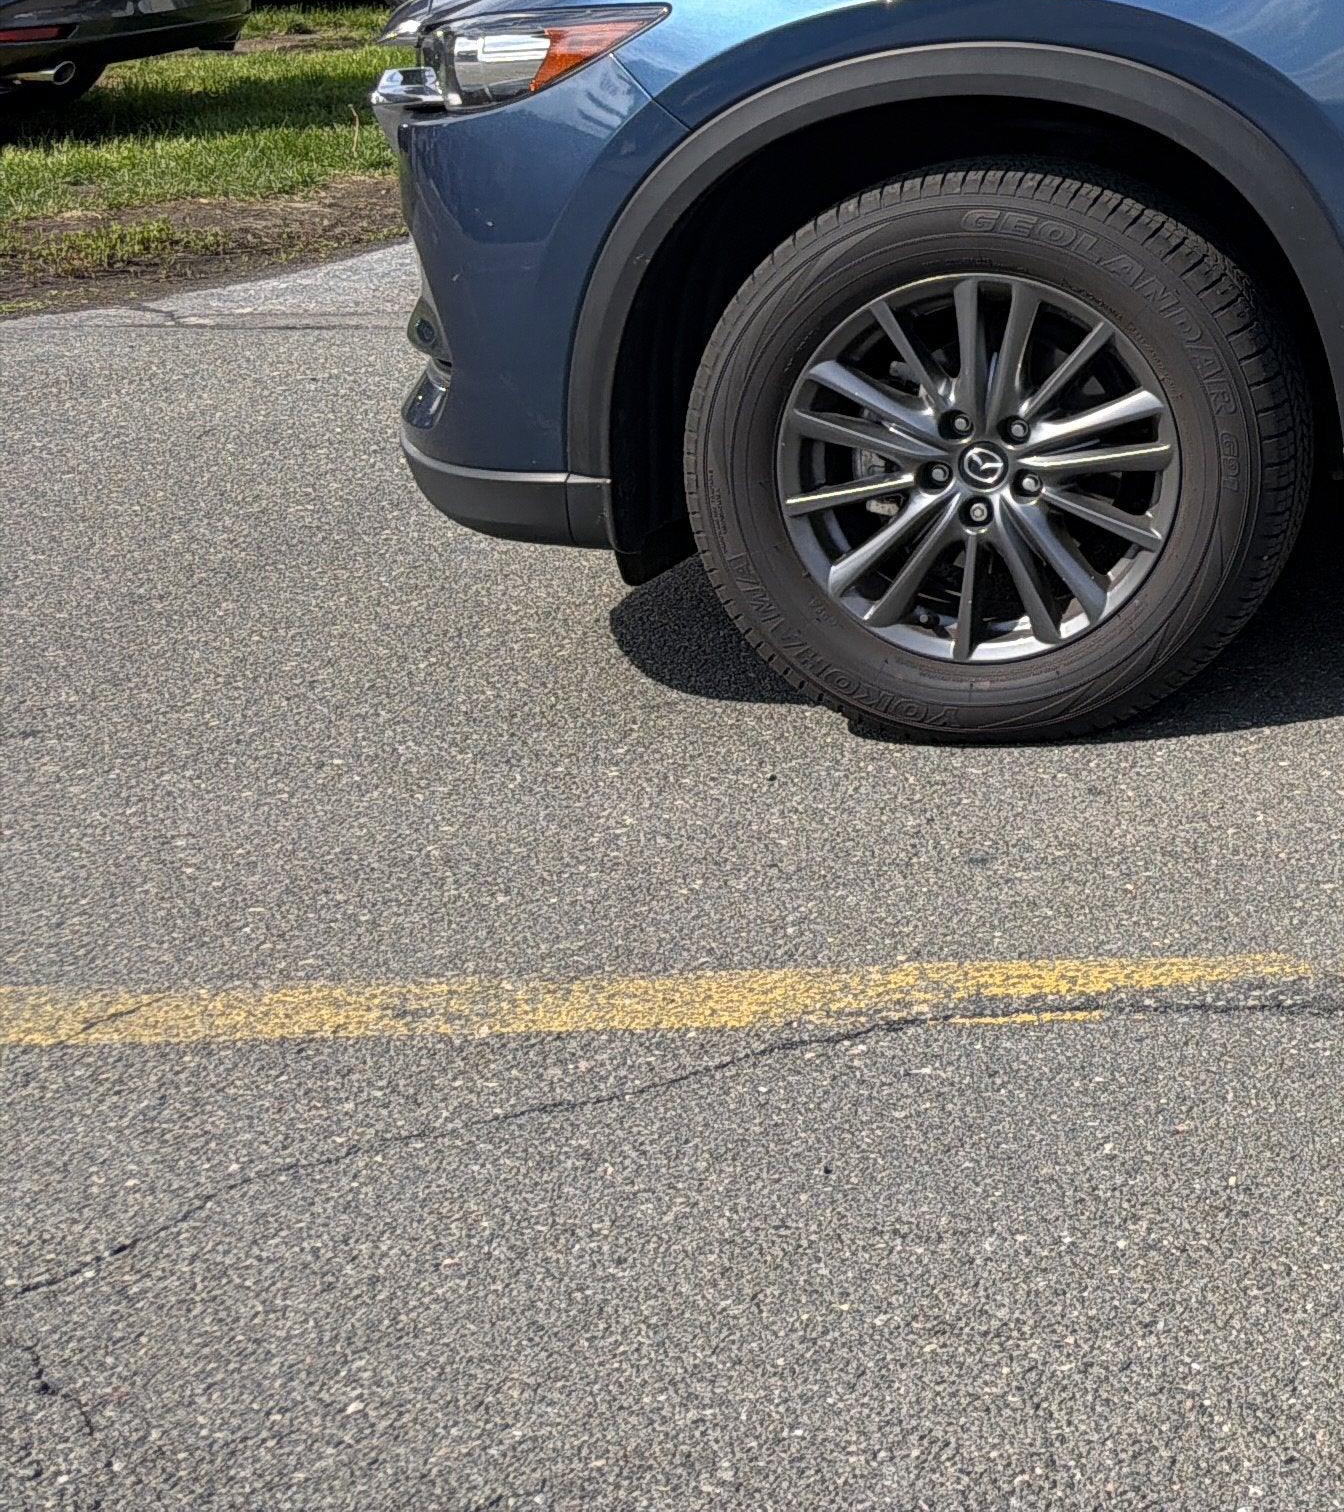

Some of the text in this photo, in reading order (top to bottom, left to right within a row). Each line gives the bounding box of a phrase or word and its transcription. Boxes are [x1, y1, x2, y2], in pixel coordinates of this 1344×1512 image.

[961, 209, 1238, 415] GEOLANDAR
[1221, 431, 1240, 492] G91
[727, 552, 961, 728] YOKOHAMA
